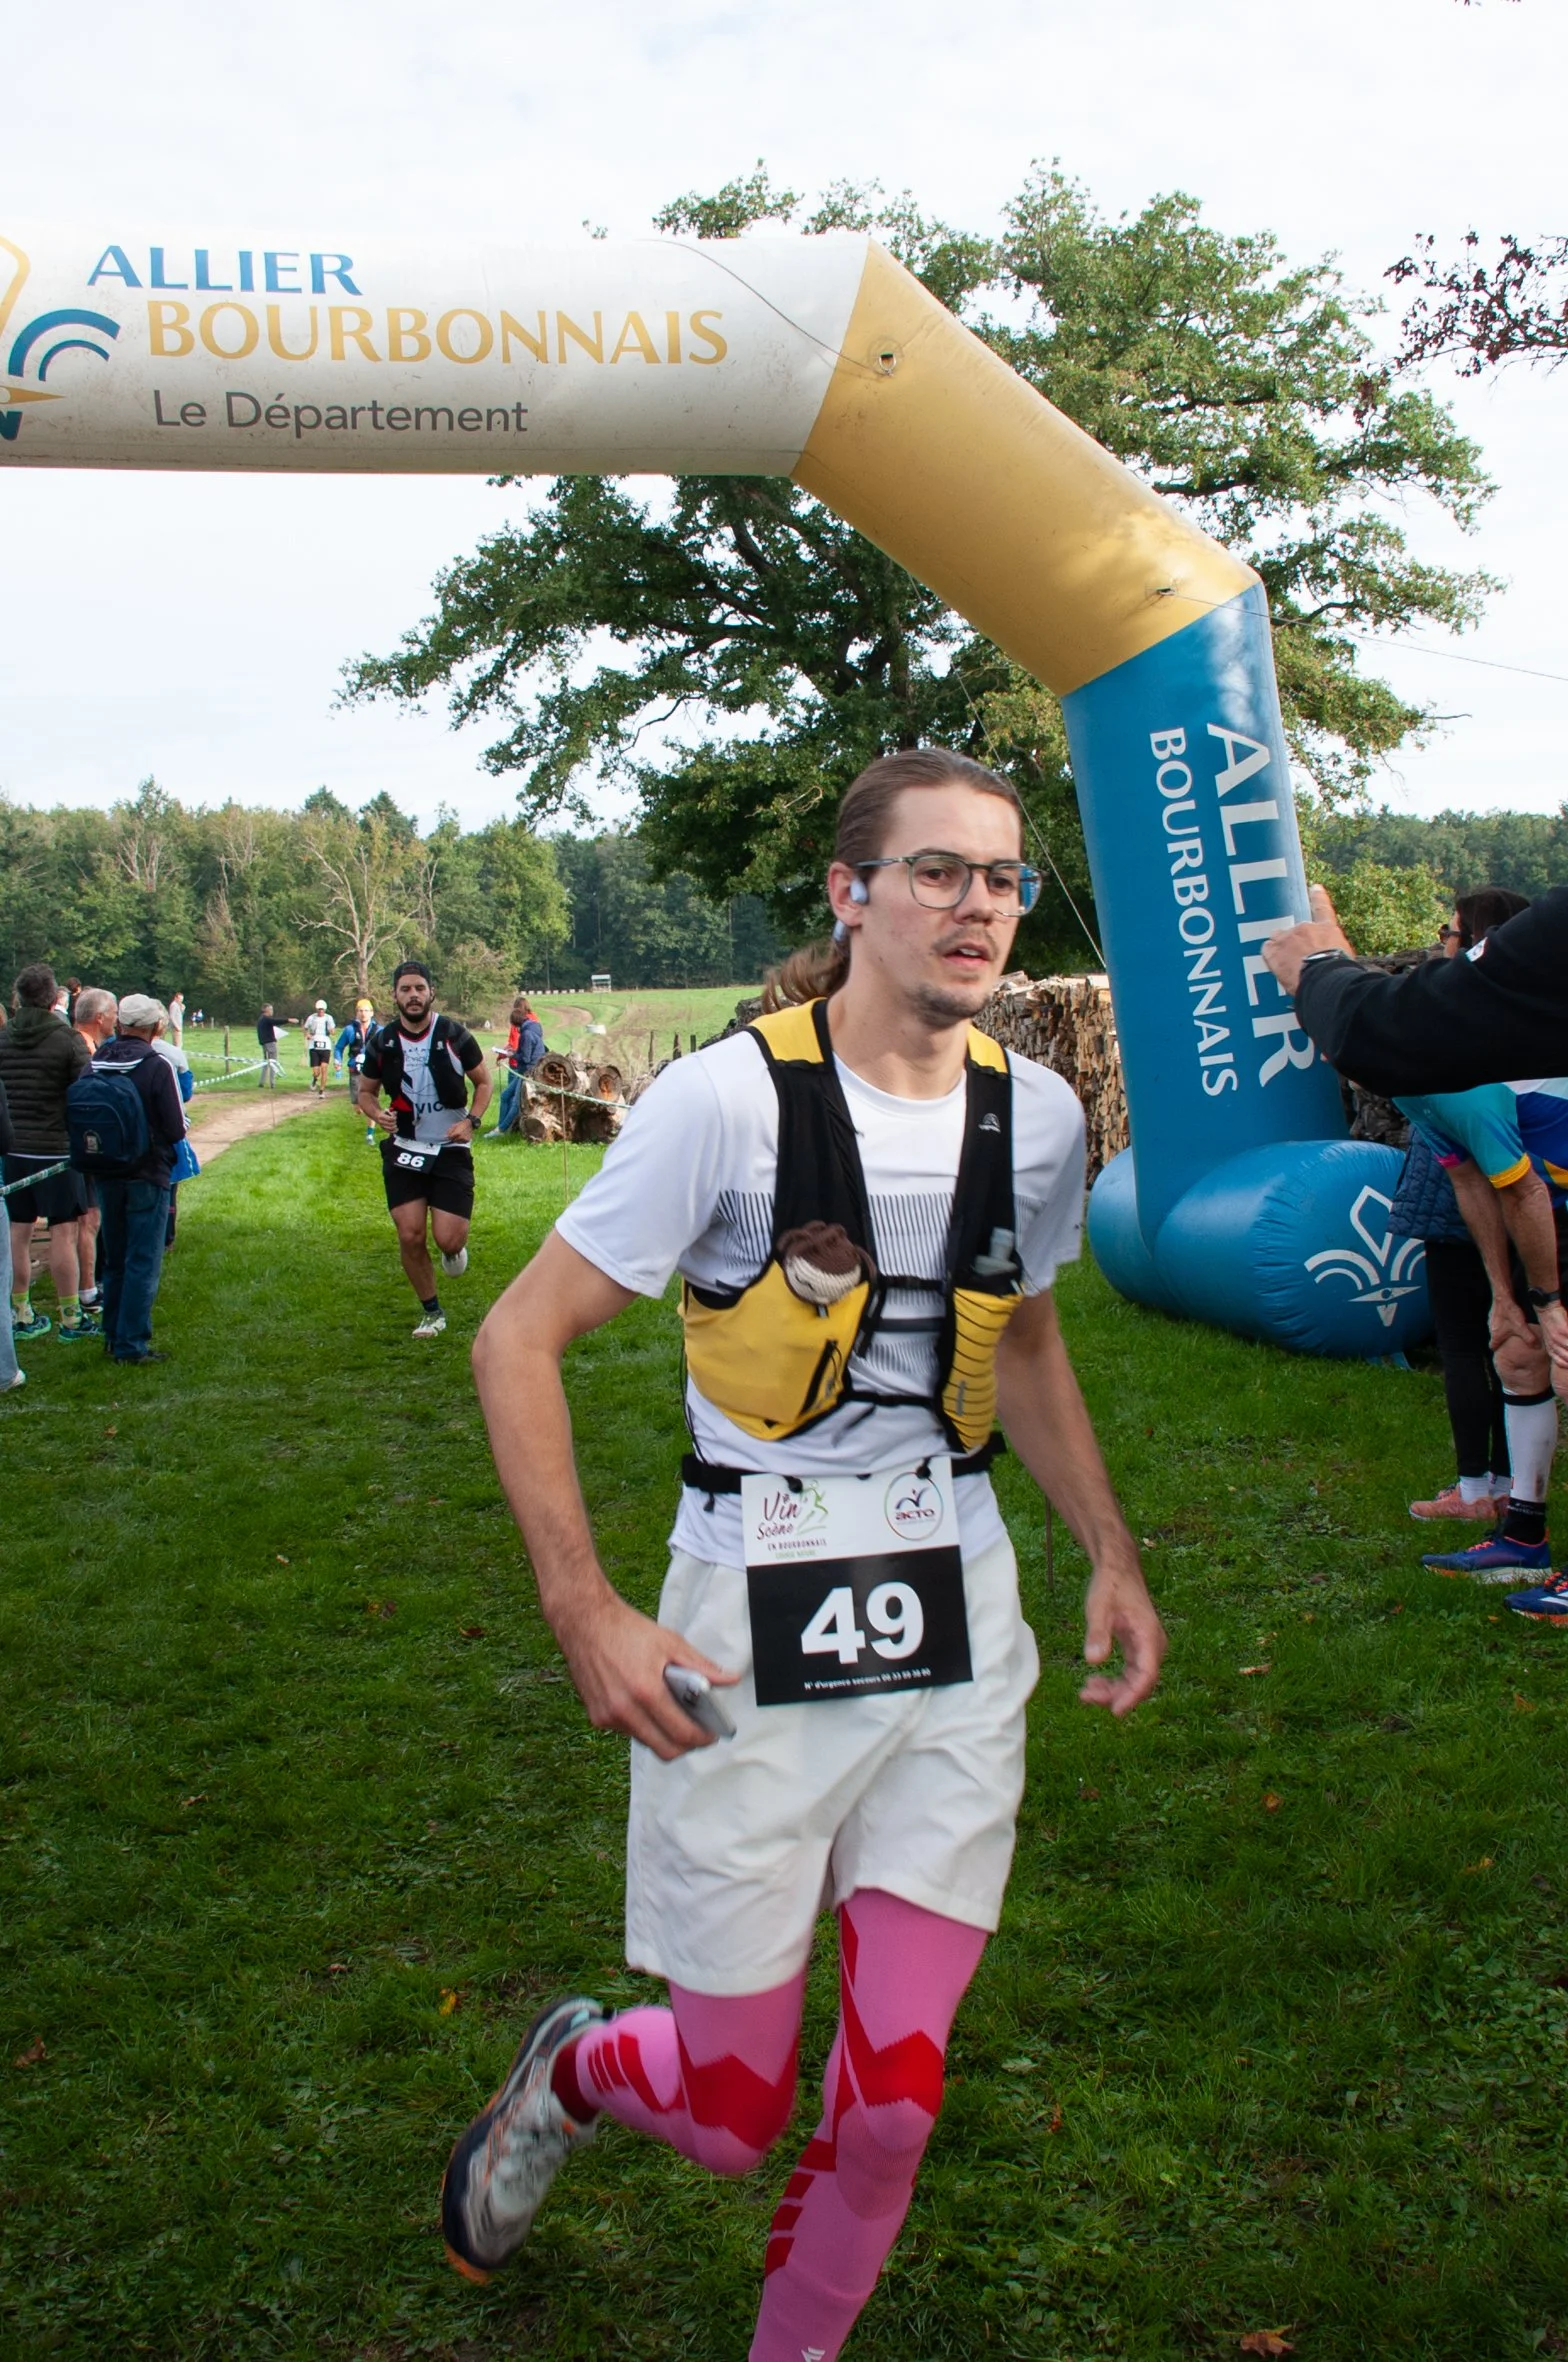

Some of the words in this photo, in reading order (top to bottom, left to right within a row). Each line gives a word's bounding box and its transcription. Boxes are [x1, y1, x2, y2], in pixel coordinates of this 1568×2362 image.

[88, 245, 361, 295] ALLIER
[148, 300, 728, 365] BOURBONNAIS
[153, 389, 208, 429] Le
[226, 391, 528, 439] Département
[1149, 727, 1238, 1097] BOURBONNAIS
[397, 1152, 425, 1168] 86
[801, 1582, 924, 1664] 49
